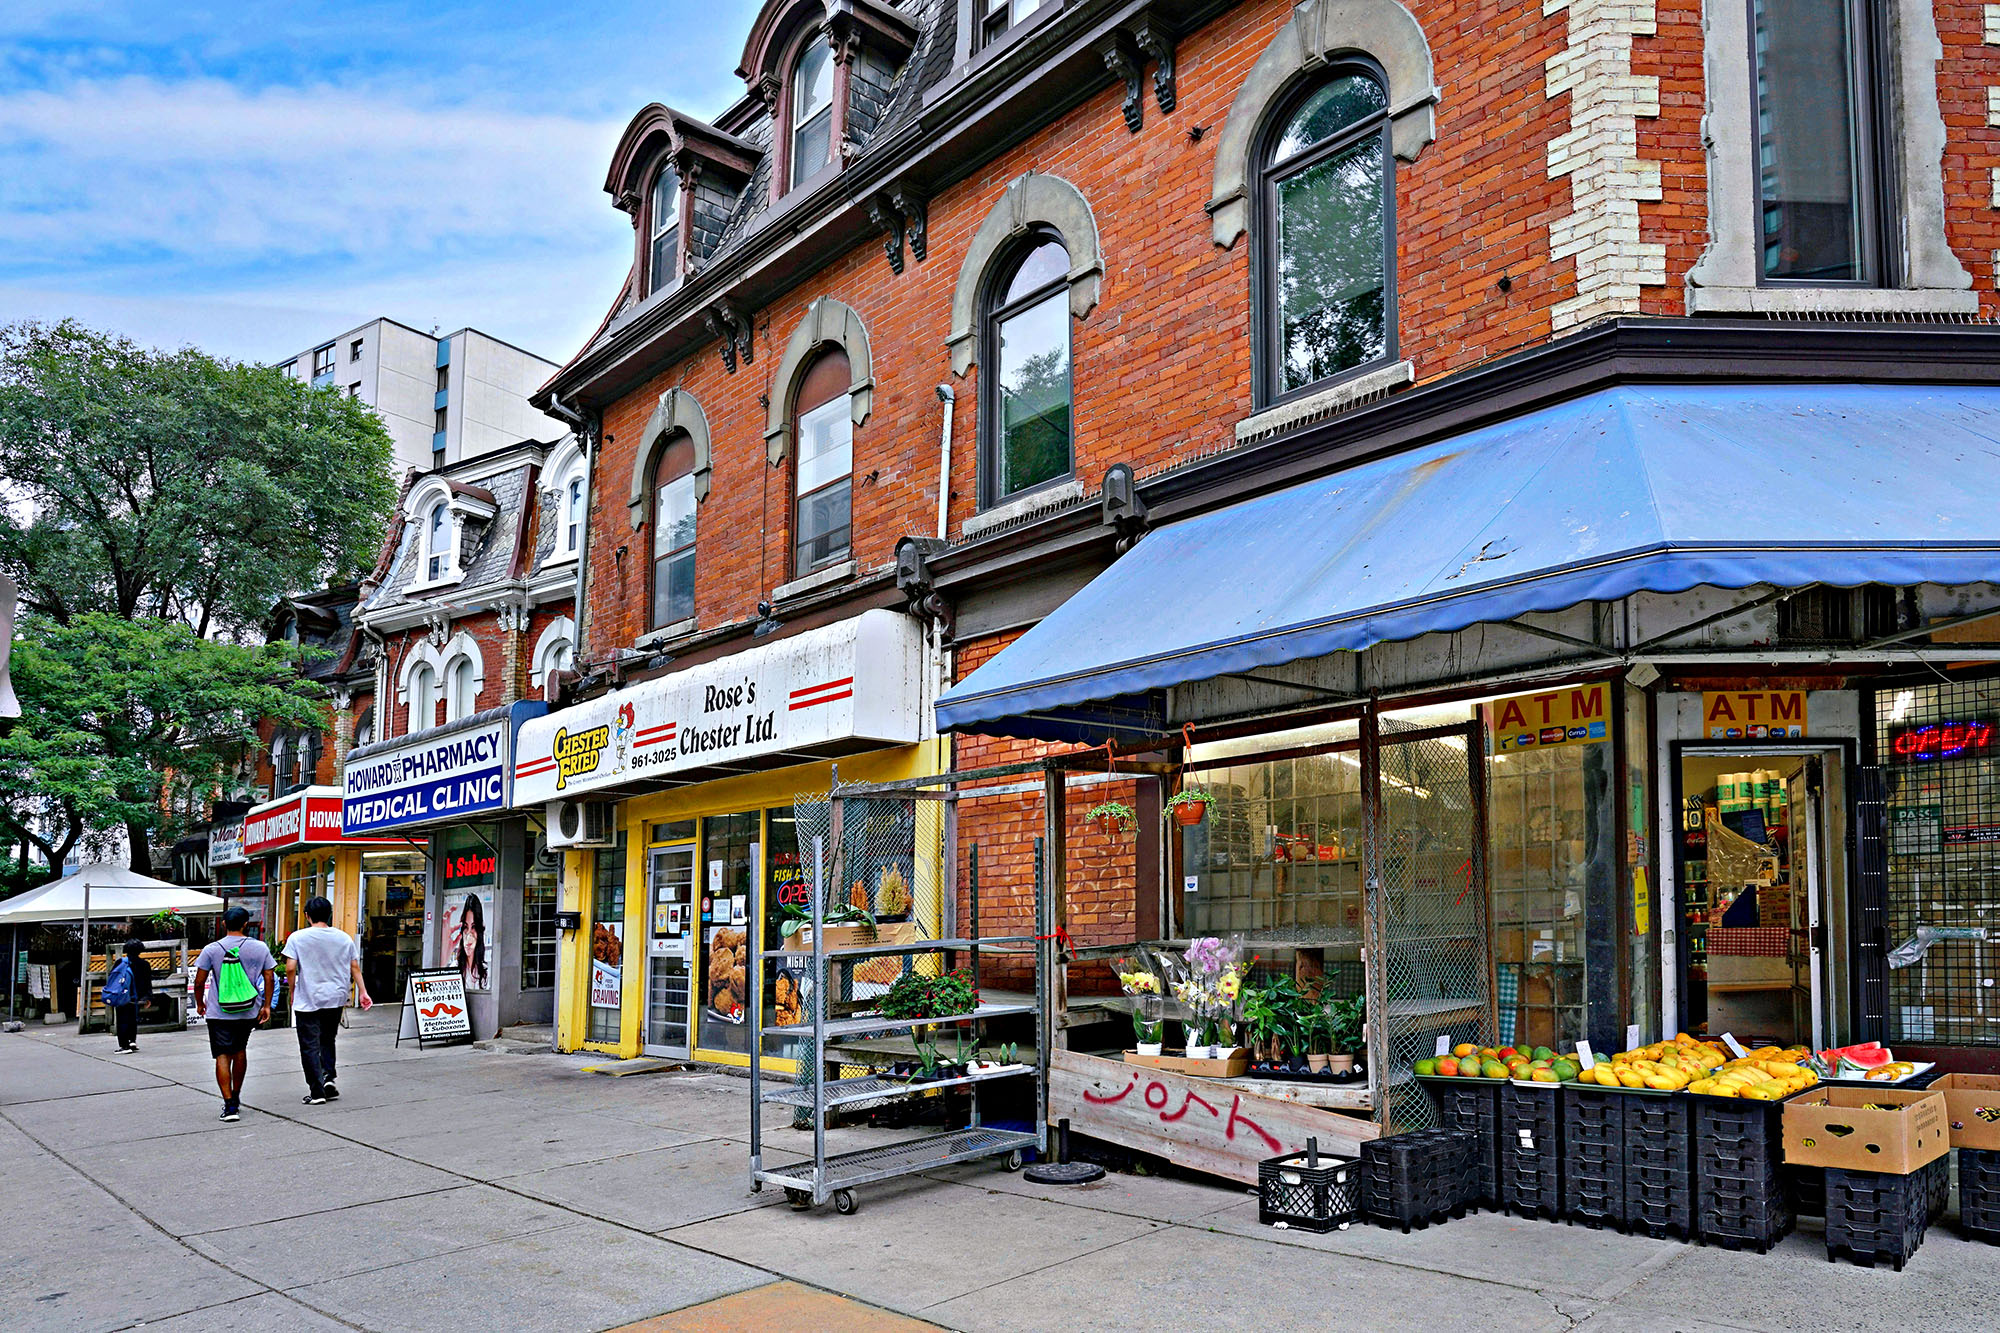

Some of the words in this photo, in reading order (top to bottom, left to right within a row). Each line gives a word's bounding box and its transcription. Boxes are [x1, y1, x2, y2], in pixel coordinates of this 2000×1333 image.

[704, 676, 756, 714] Rose's
[1499, 686, 1603, 731] ATM
[1708, 693, 1801, 721] ATM
[554, 725, 609, 760] CHESTER
[680, 722, 741, 756] Chester
[745, 710, 778, 745] Ltd.
[1568, 729, 1586, 737] Cirrus
[1895, 727, 1990, 754] OPEN
[348, 763, 392, 794] HOWARD
[403, 731, 500, 782] PHARMACY
[557, 750, 599, 790] FRIED
[632, 747, 677, 769] 961-3025
[347, 792, 428, 826] MEDICAL
[432, 774, 502, 811] CLINIC
[246, 820, 266, 847] HOWARD
[266, 808, 300, 842] CONVENIENCE
[309, 811, 342, 828] HOWA
[446, 858, 453, 879] h
[456, 854, 496, 878] Subox
[774, 868, 792, 882] FISH
[795, 868, 801, 881] &
[779, 883, 813, 903] OPE
[593, 989, 619, 1005] CRAVING
[431, 1024, 466, 1032] Suboxone
